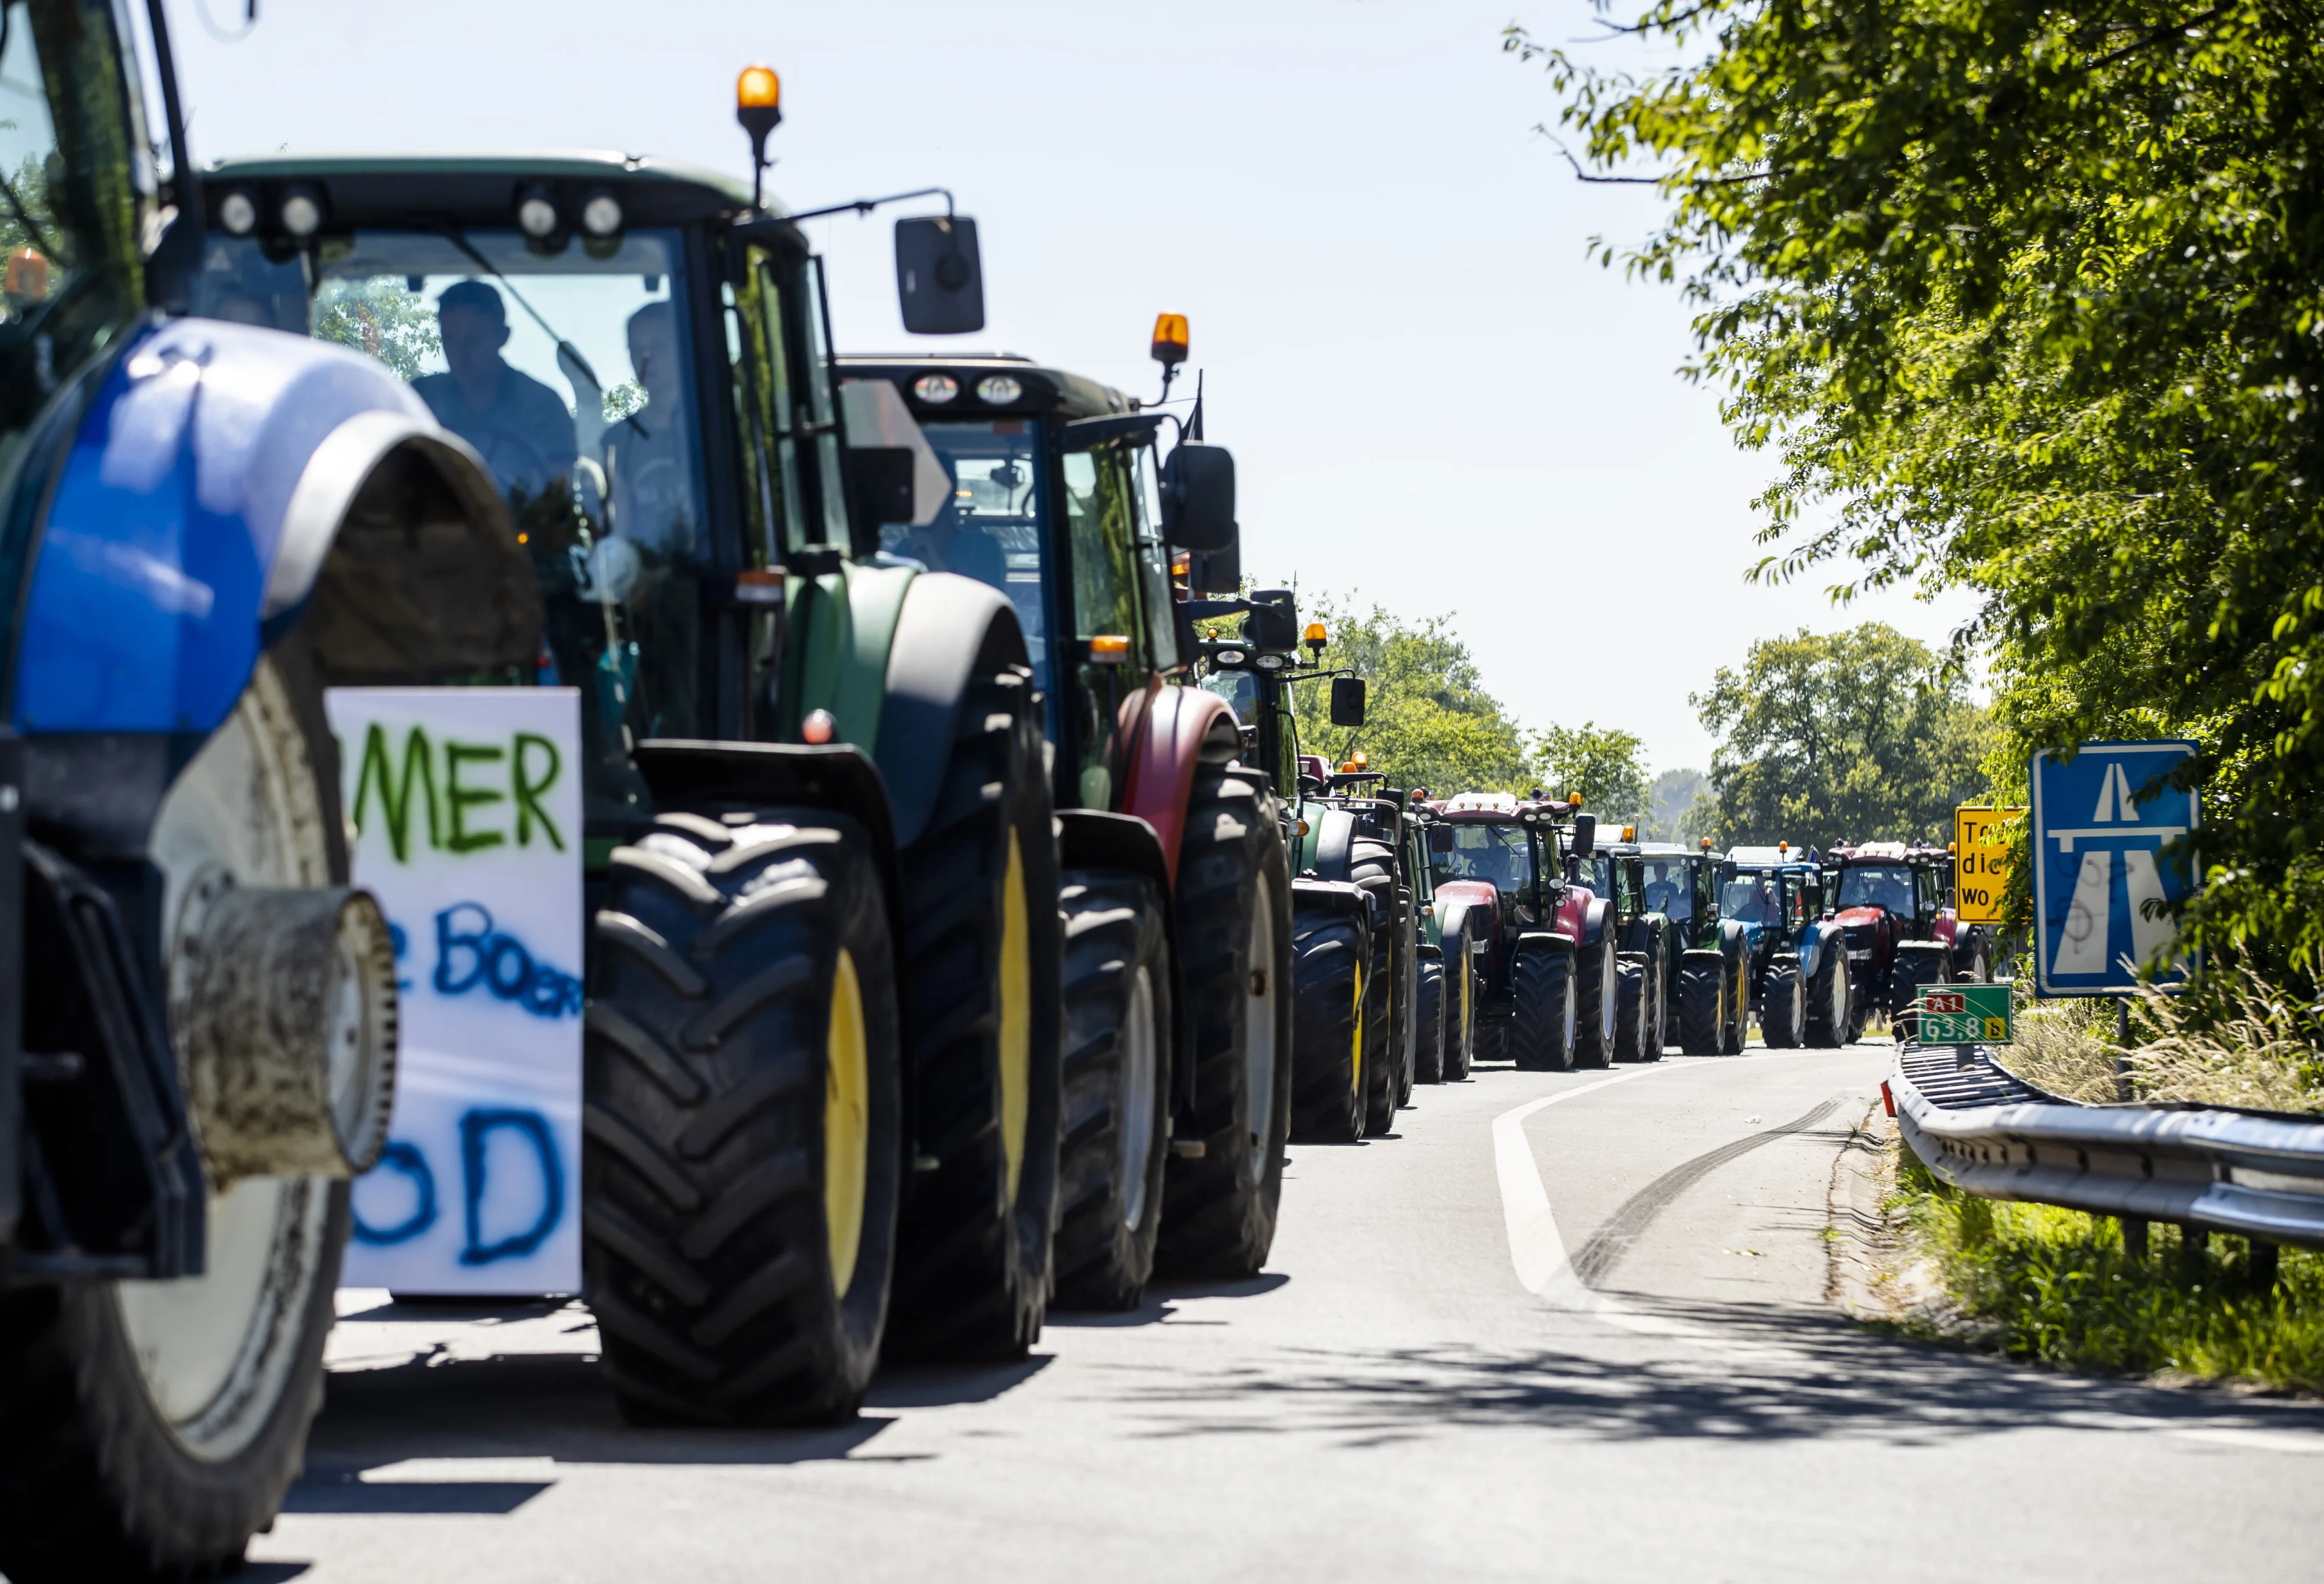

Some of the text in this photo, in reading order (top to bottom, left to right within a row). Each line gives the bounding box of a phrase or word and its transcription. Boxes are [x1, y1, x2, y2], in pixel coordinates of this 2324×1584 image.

[341, 720, 566, 864] MER
[1933, 997, 1957, 1011] A1
[1925, 1017, 2001, 1040] 63,8 b
